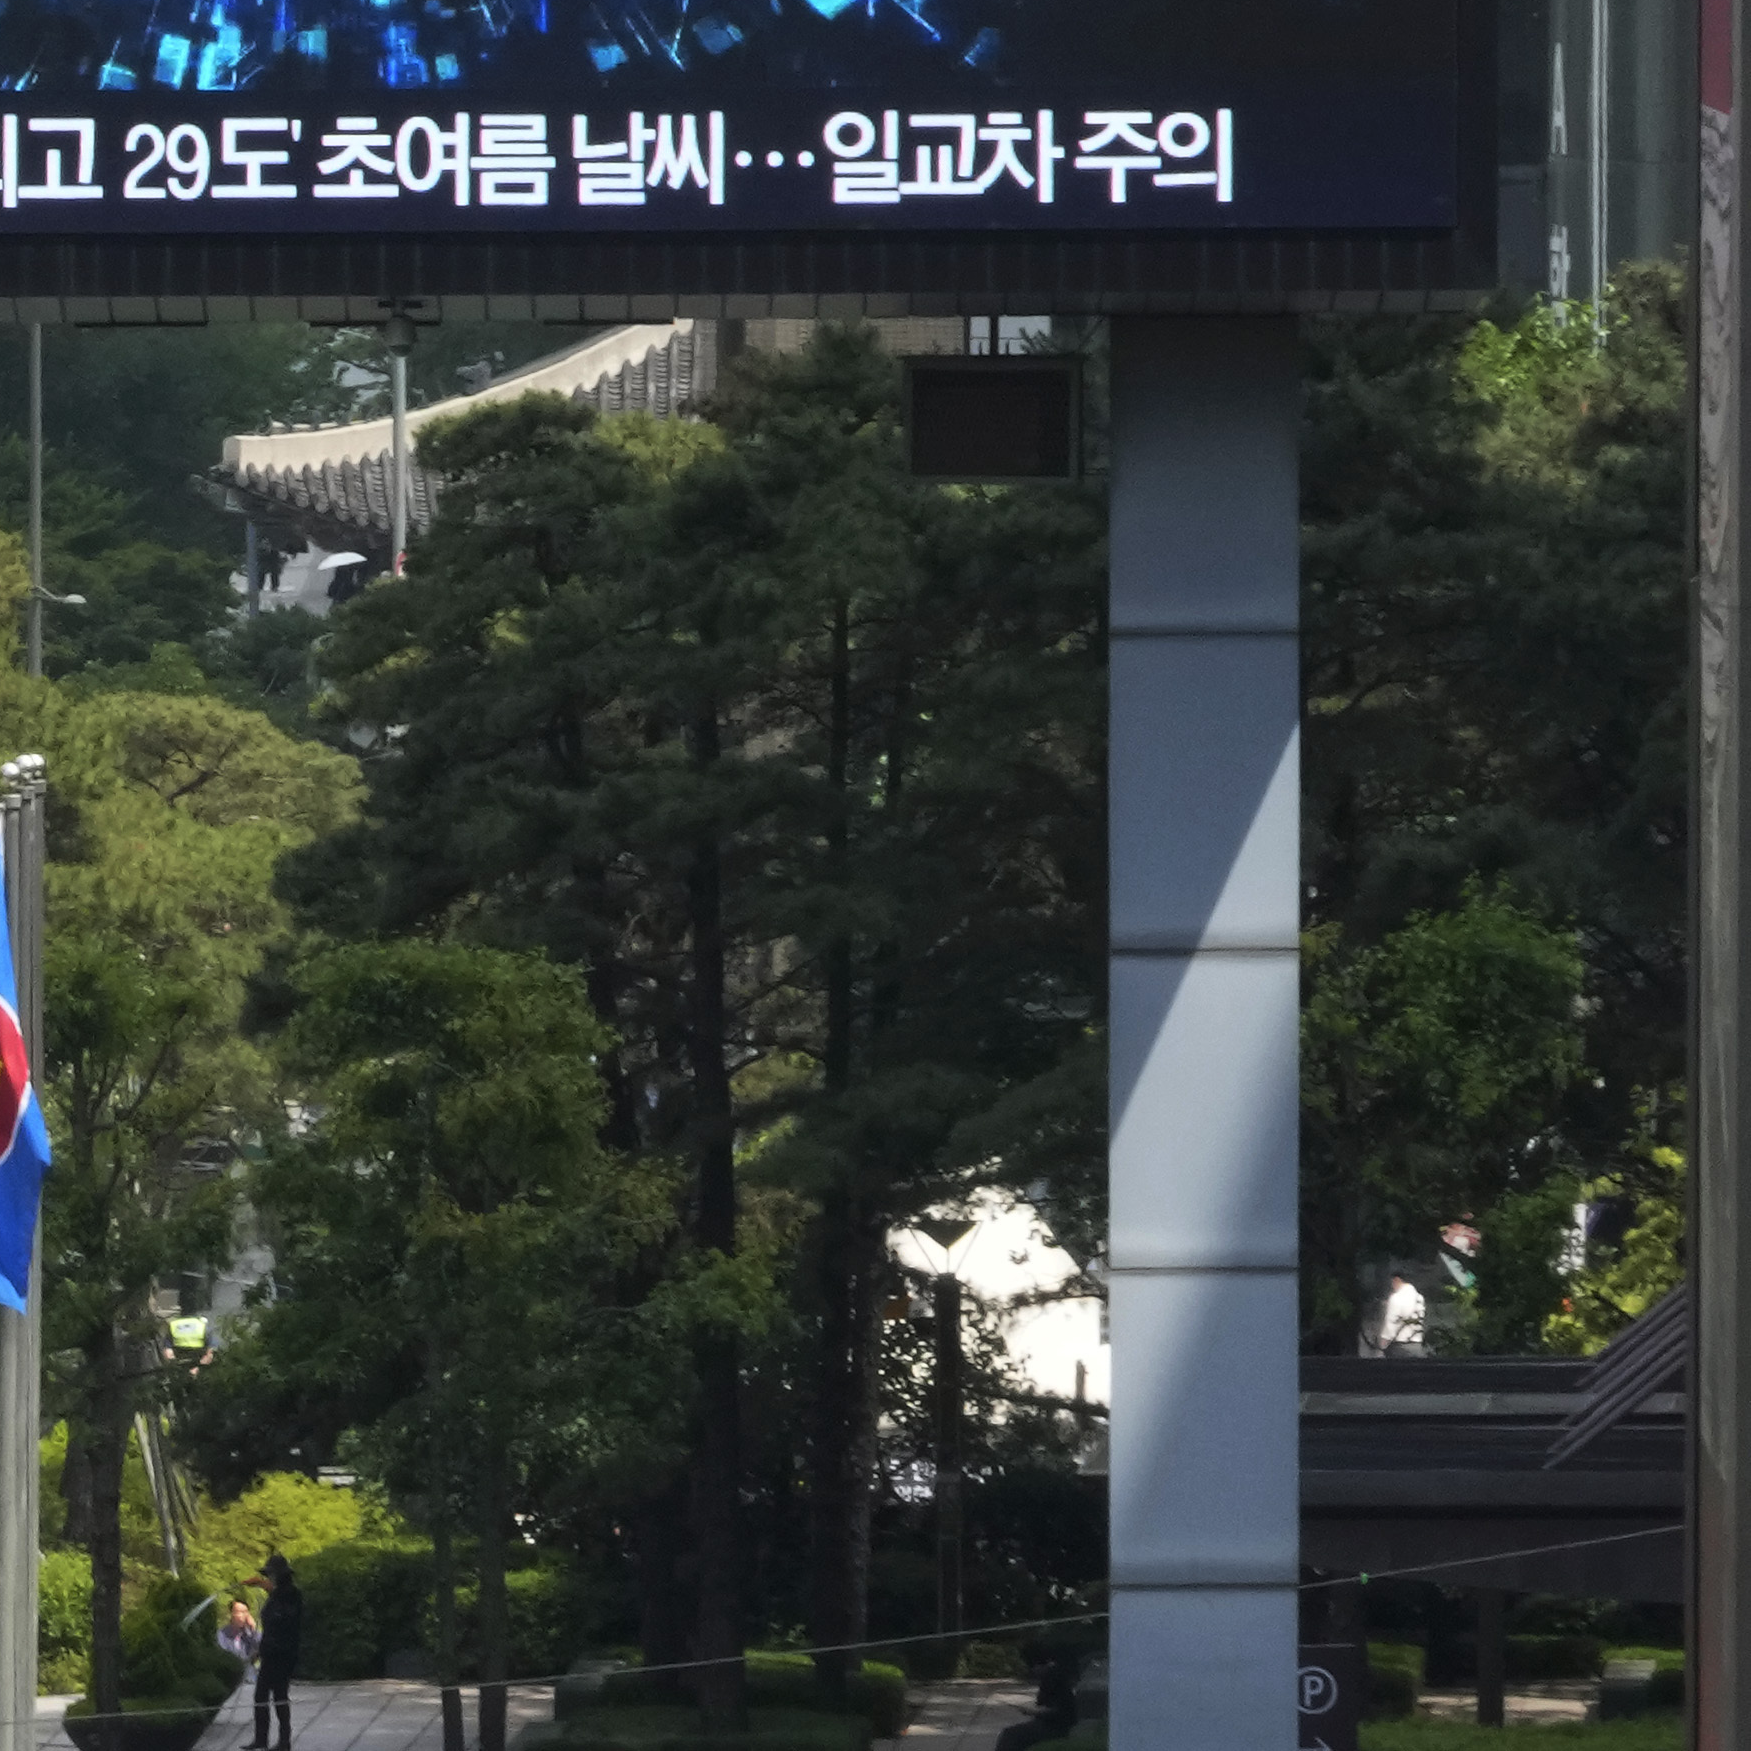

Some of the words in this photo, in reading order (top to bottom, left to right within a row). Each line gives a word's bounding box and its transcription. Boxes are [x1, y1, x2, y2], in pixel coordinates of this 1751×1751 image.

[312, 111, 557, 206] 초여름
[1074, 108, 1233, 204] 주의
[1303, 1674, 1325, 1707] P
